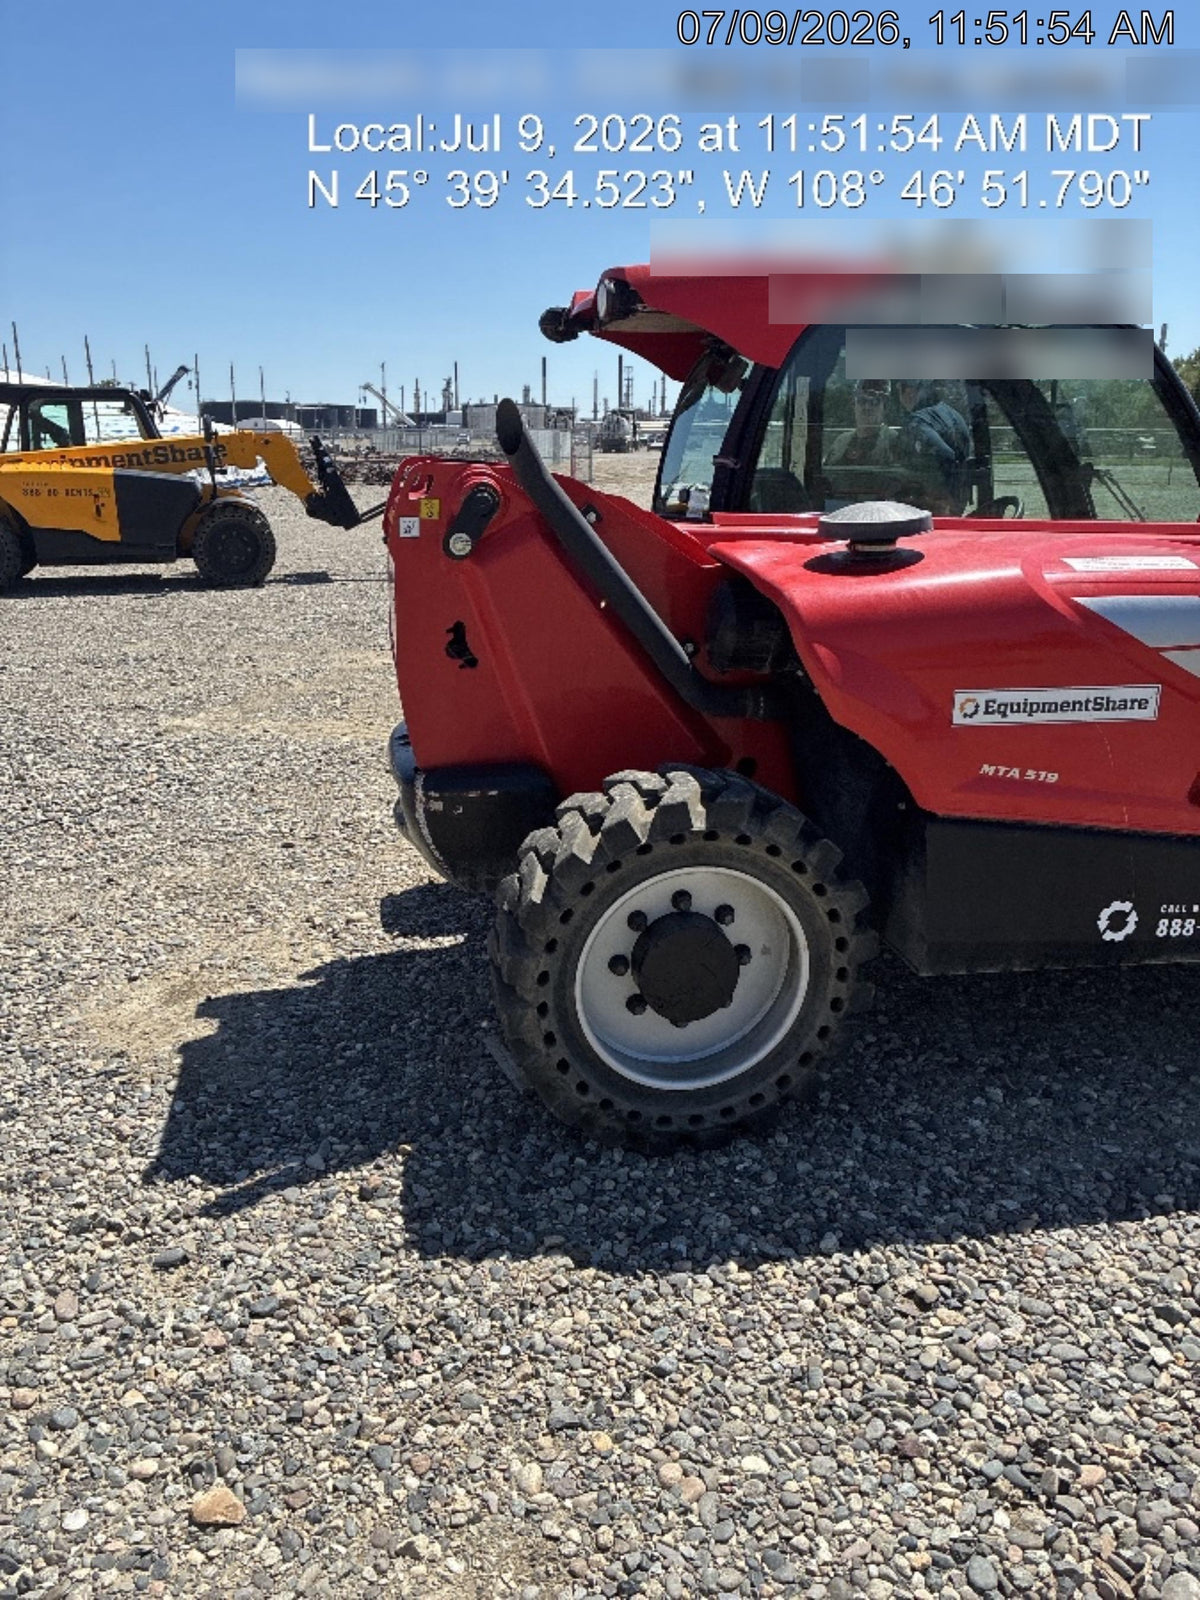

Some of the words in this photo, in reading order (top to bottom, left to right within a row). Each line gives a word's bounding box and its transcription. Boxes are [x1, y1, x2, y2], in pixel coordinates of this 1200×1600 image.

[982, 695, 1150, 718] EquipmentShare
[979, 763, 1020, 780] MTA
[1023, 769, 1060, 784] 519
[1160, 904, 1188, 914] CALL
